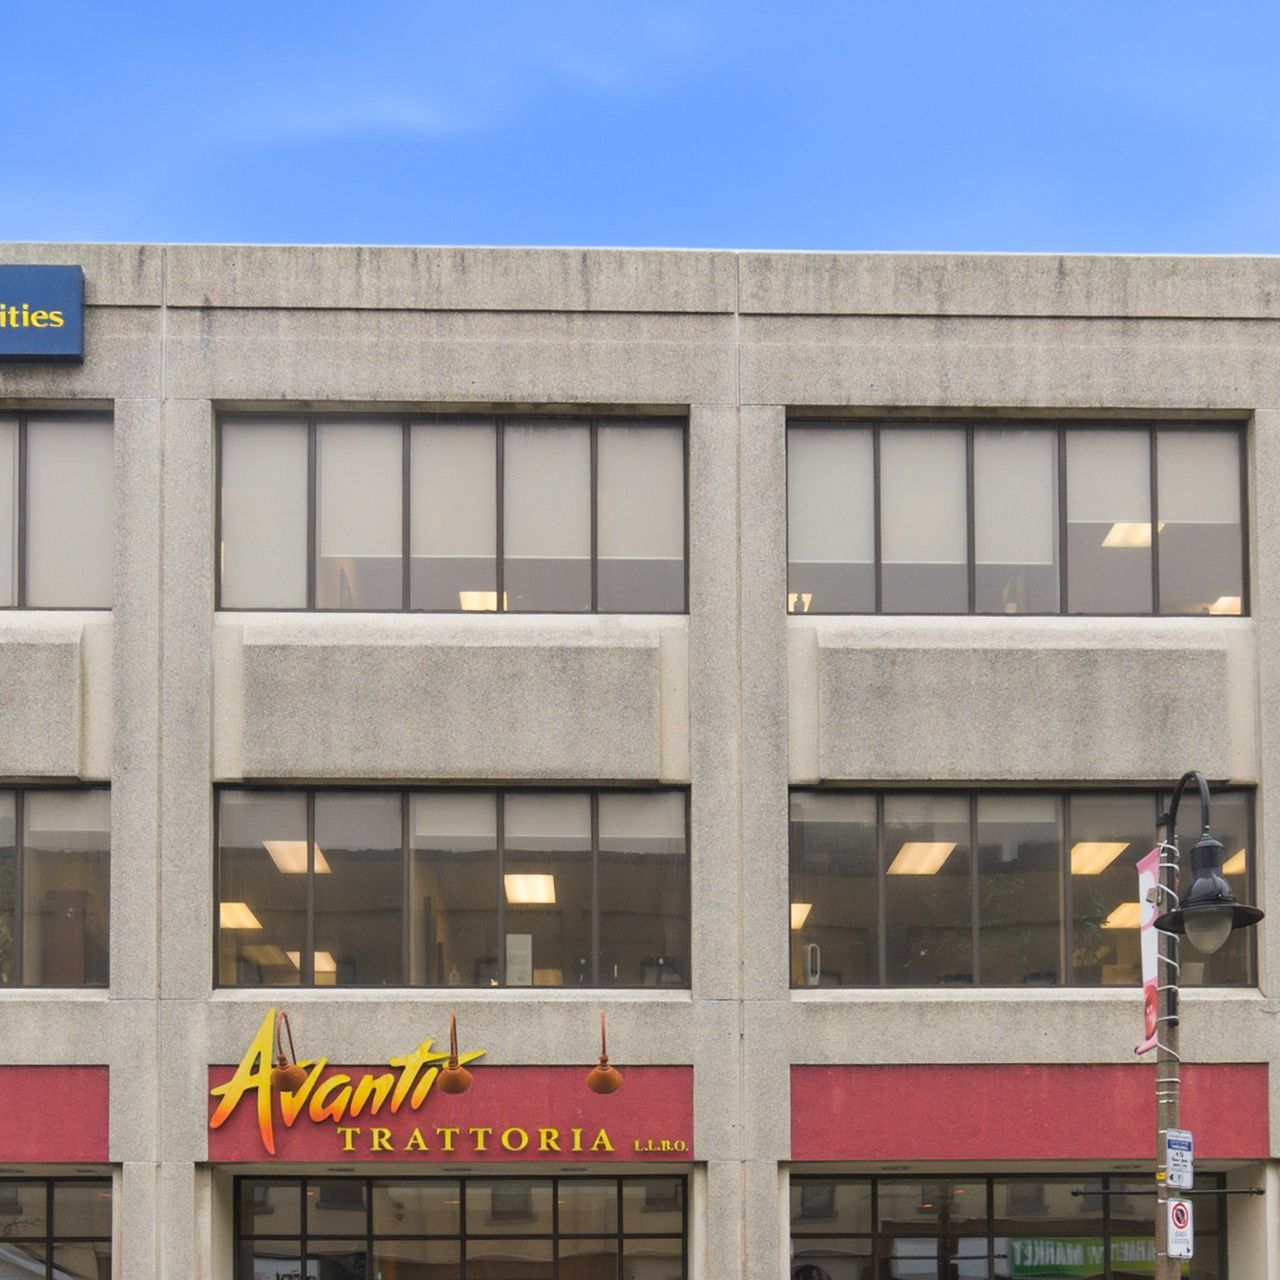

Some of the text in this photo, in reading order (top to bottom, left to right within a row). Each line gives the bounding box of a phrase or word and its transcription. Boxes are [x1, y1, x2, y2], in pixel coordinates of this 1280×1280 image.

[209, 1007, 487, 1156] Avanti
[336, 1126, 689, 1153] TRATTORIA L.L.B.O.
